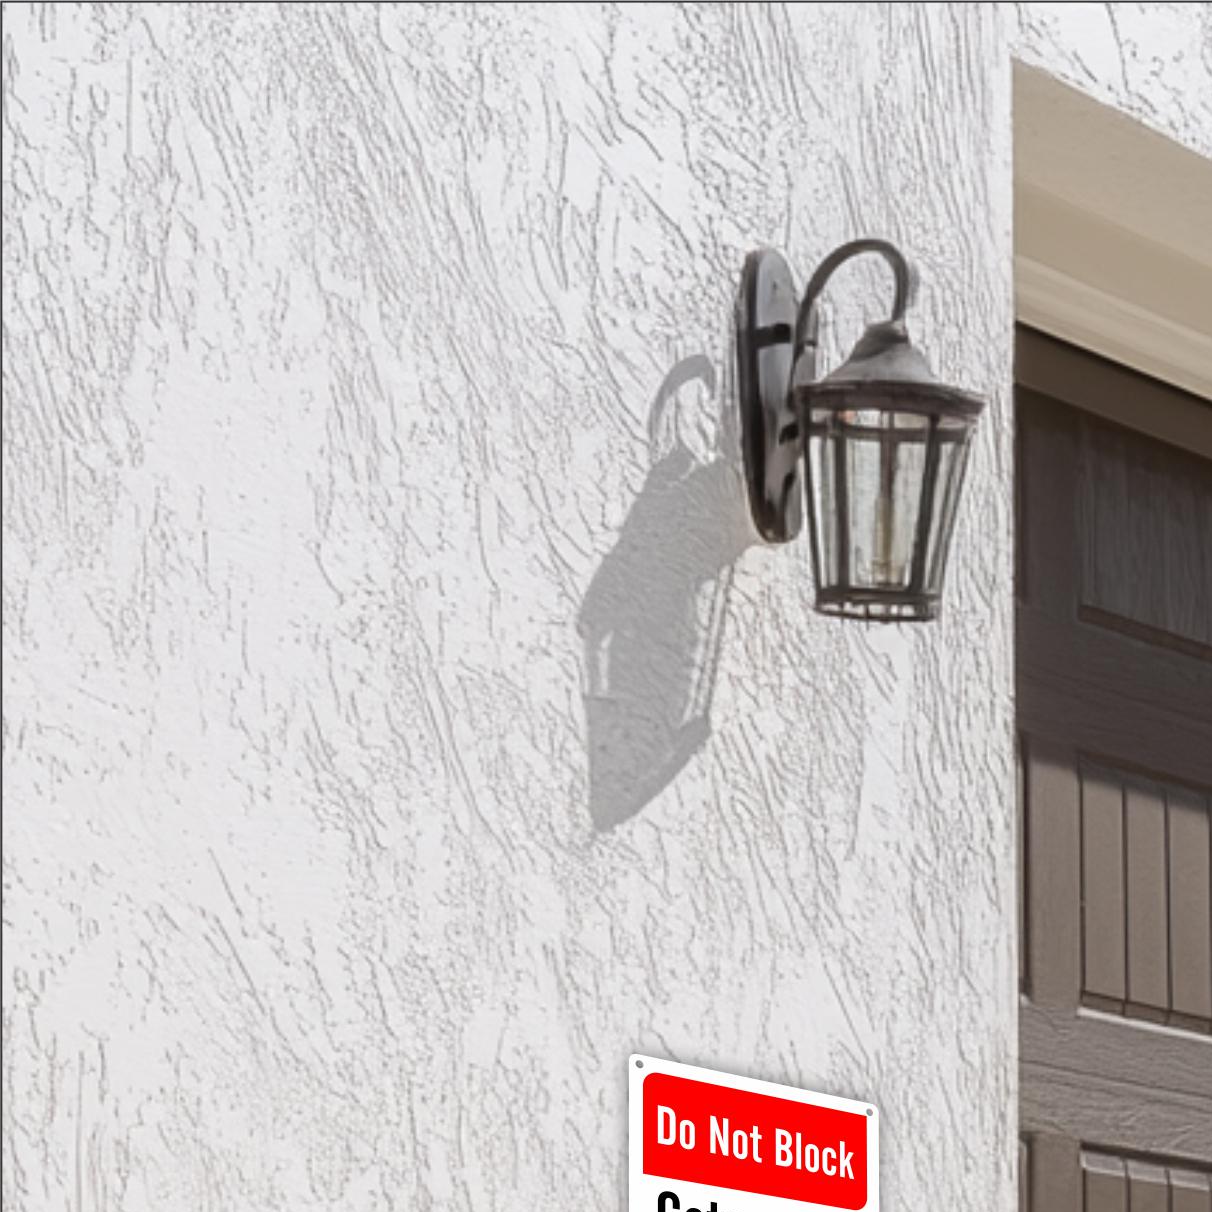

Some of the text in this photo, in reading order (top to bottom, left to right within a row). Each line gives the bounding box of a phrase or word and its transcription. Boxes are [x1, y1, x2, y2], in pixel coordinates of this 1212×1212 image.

[657, 1104, 855, 1180] Do Not Block
